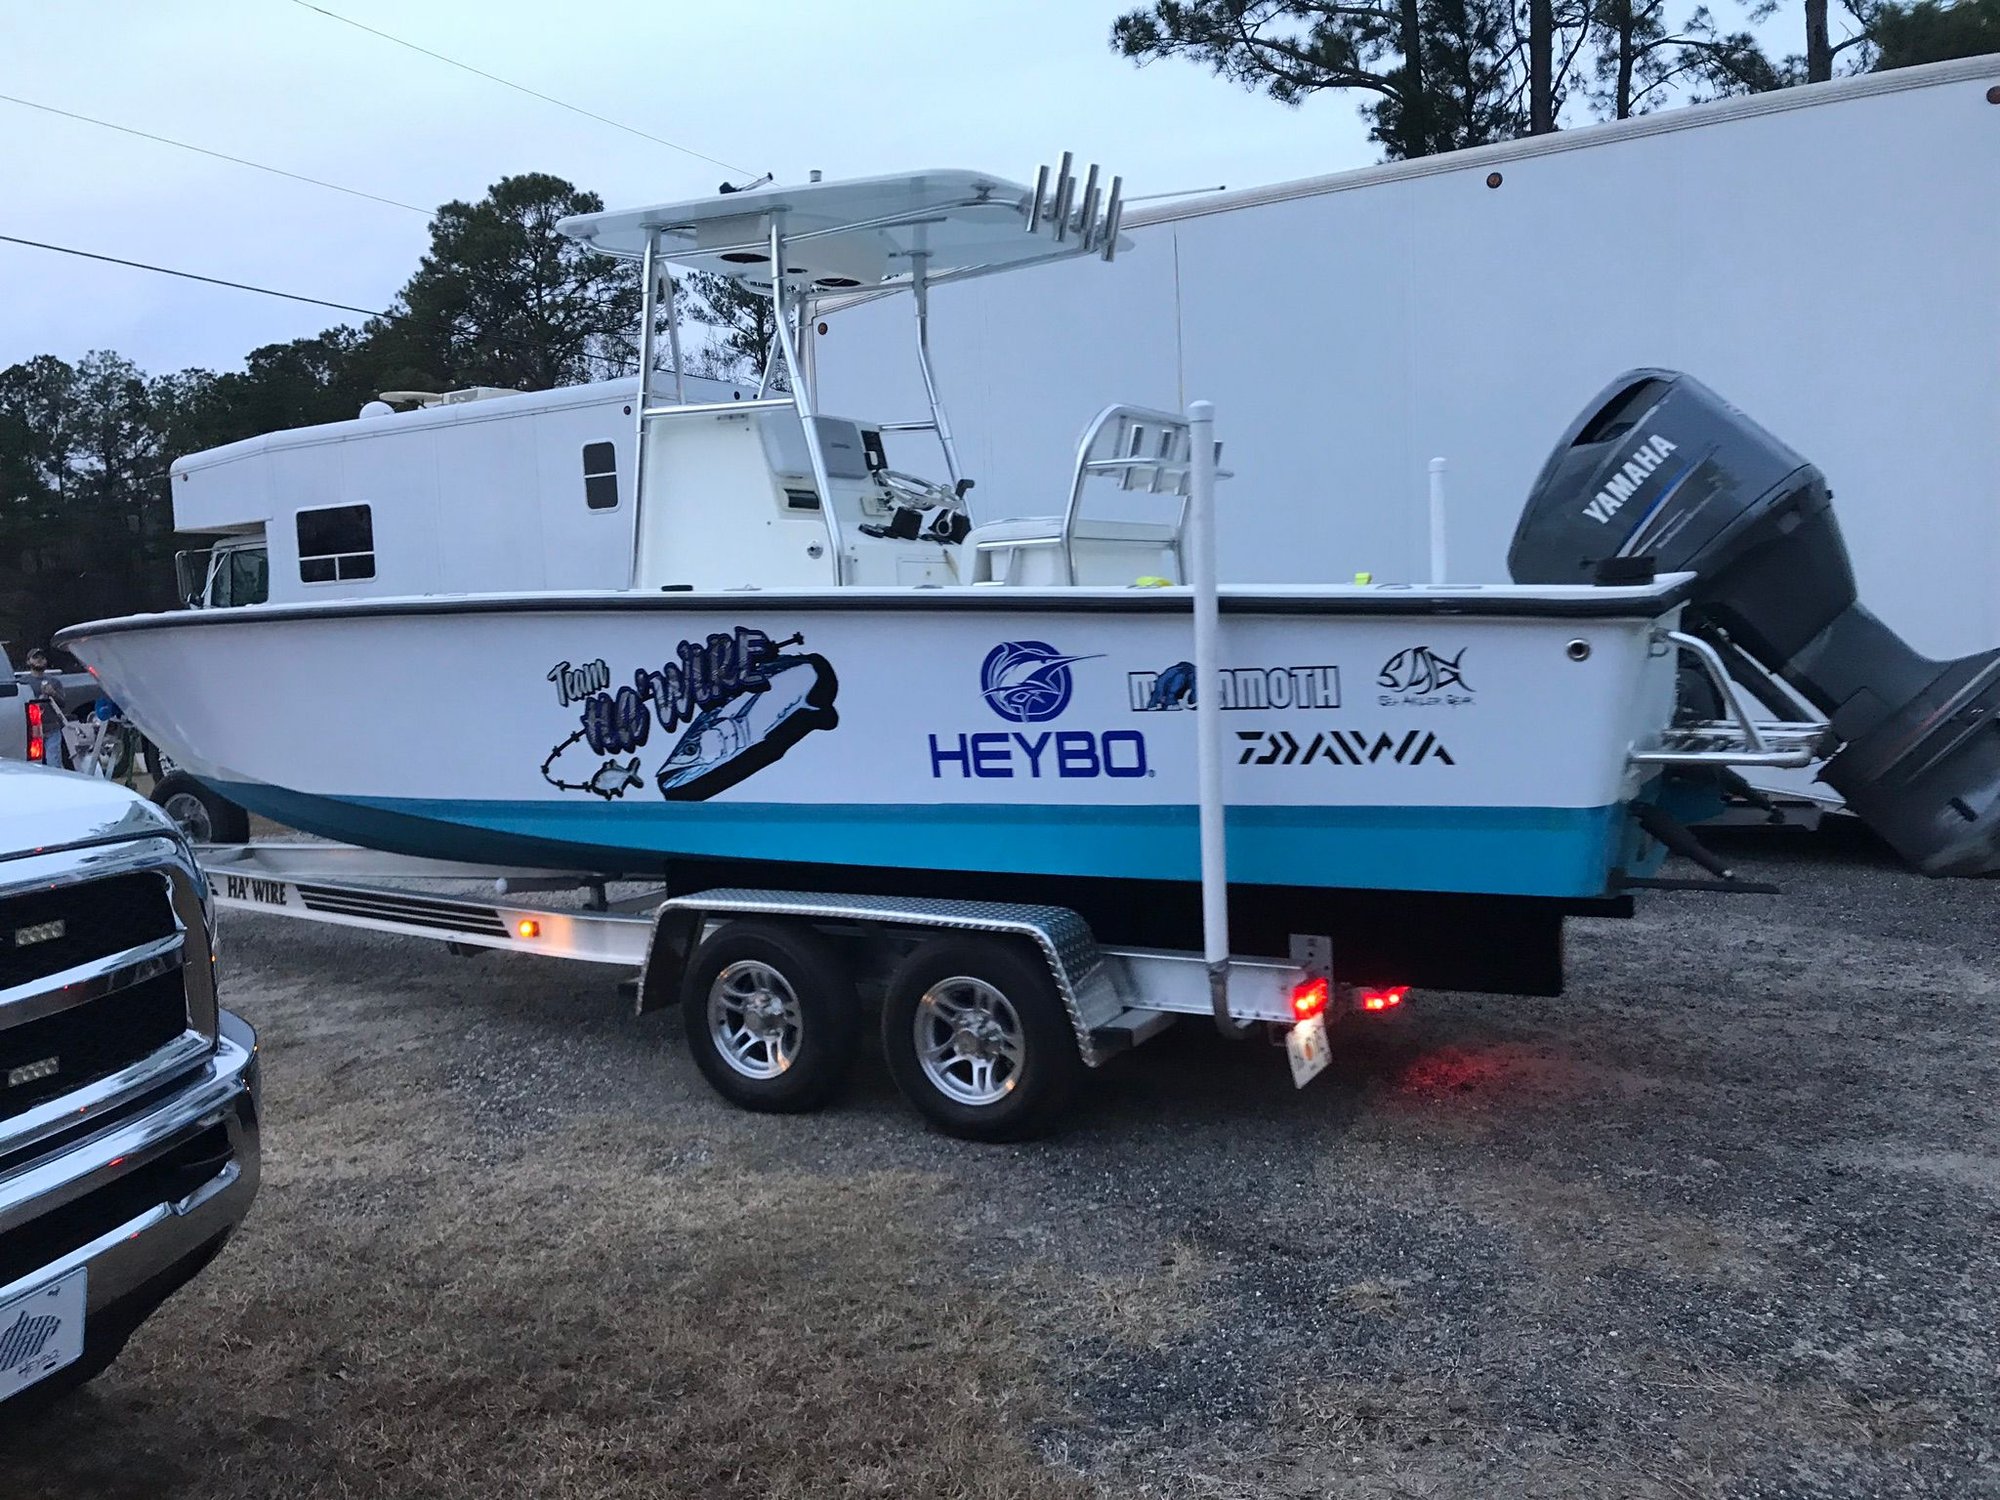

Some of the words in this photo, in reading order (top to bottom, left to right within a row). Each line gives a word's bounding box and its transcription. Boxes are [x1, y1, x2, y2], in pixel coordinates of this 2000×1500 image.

[1582, 434, 1679, 524] YAMAHA
[548, 658, 610, 707] Team
[928, 730, 1147, 778] HEYBO
[1236, 730, 1456, 765] DAIWA
